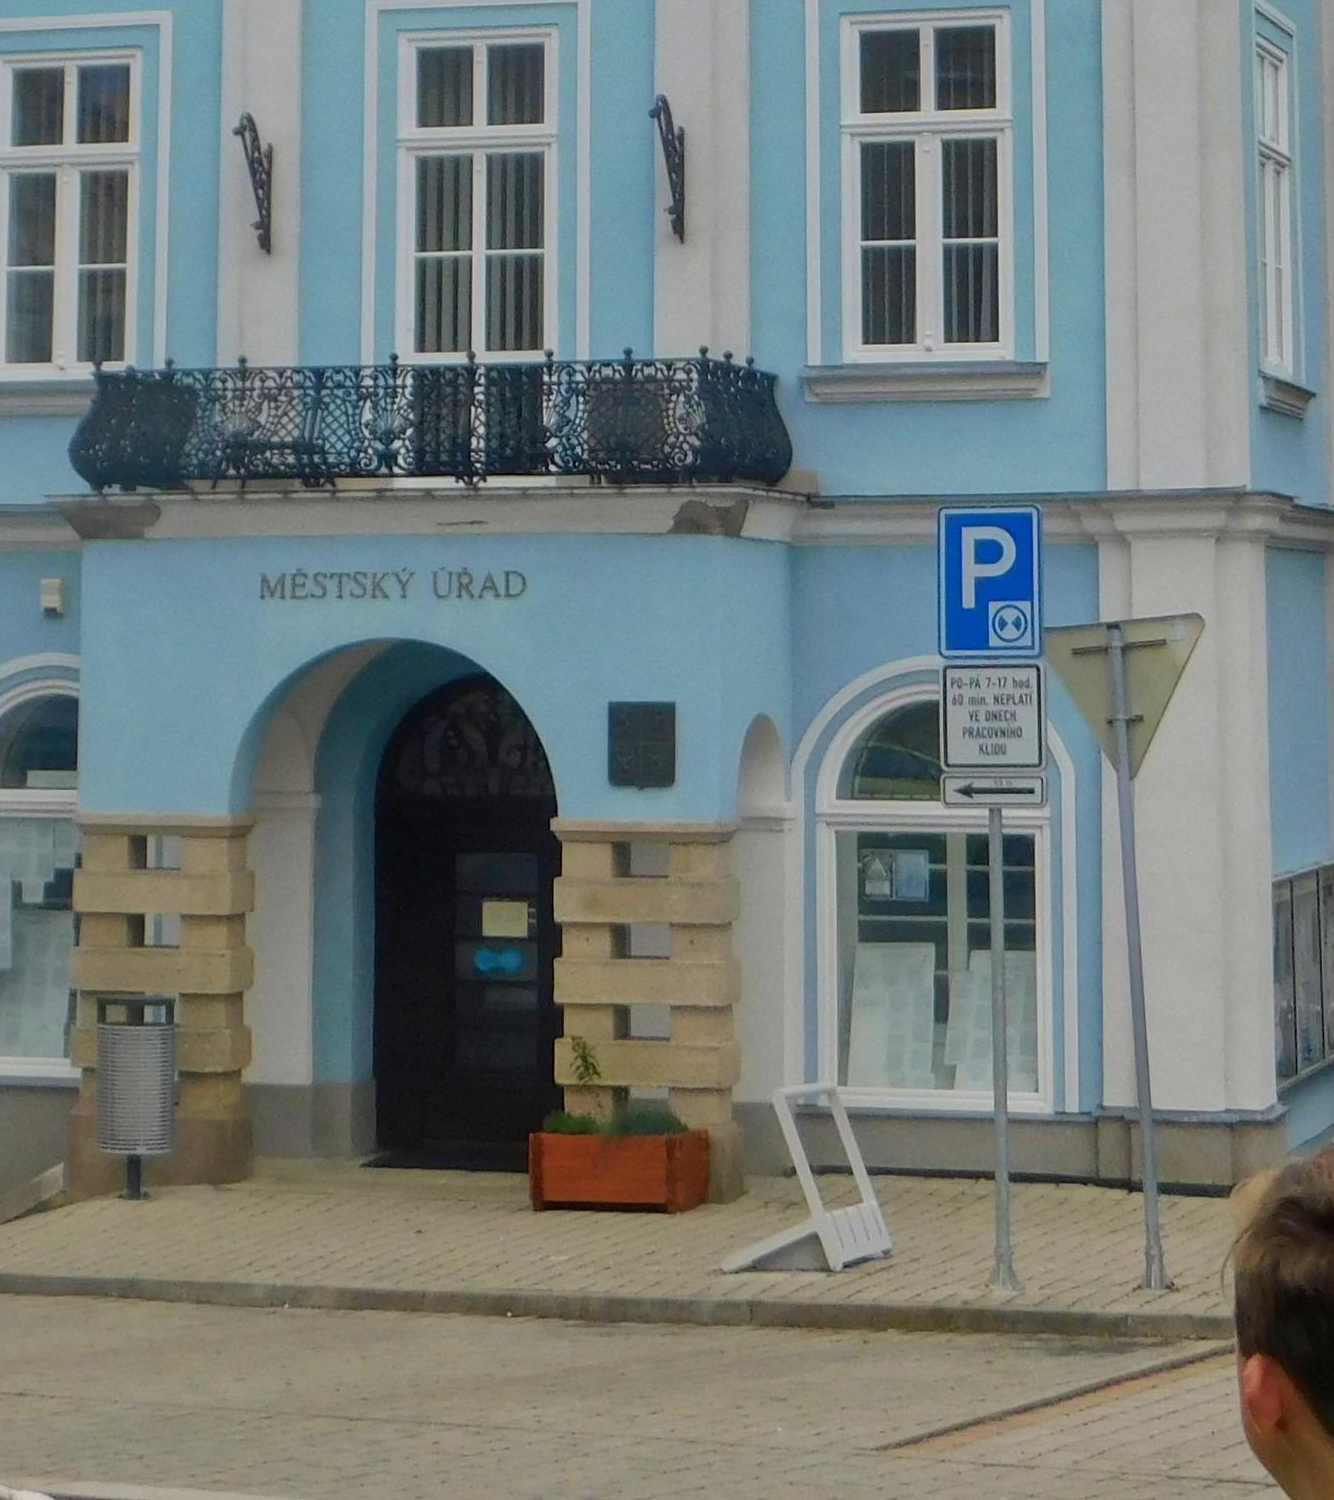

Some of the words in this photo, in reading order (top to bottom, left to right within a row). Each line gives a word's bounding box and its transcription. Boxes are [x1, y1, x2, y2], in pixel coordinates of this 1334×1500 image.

[960, 525, 1017, 610] P
[258, 566, 416, 601] MĚSTSKÝ
[431, 566, 527, 601] ÚŘAD
[950, 674, 981, 690] PO-PÁ
[986, 676, 1008, 690] 7-17
[1012, 676, 1033, 690] hod.
[951, 693, 964, 706] 60
[968, 692, 989, 707] min.
[993, 690, 1033, 706] NEPLATÍ
[968, 709, 980, 722] VE
[985, 709, 1017, 722] DNECH
[962, 723, 1023, 739] PRACOVNÍHO
[978, 742, 1007, 756] KLIDU
